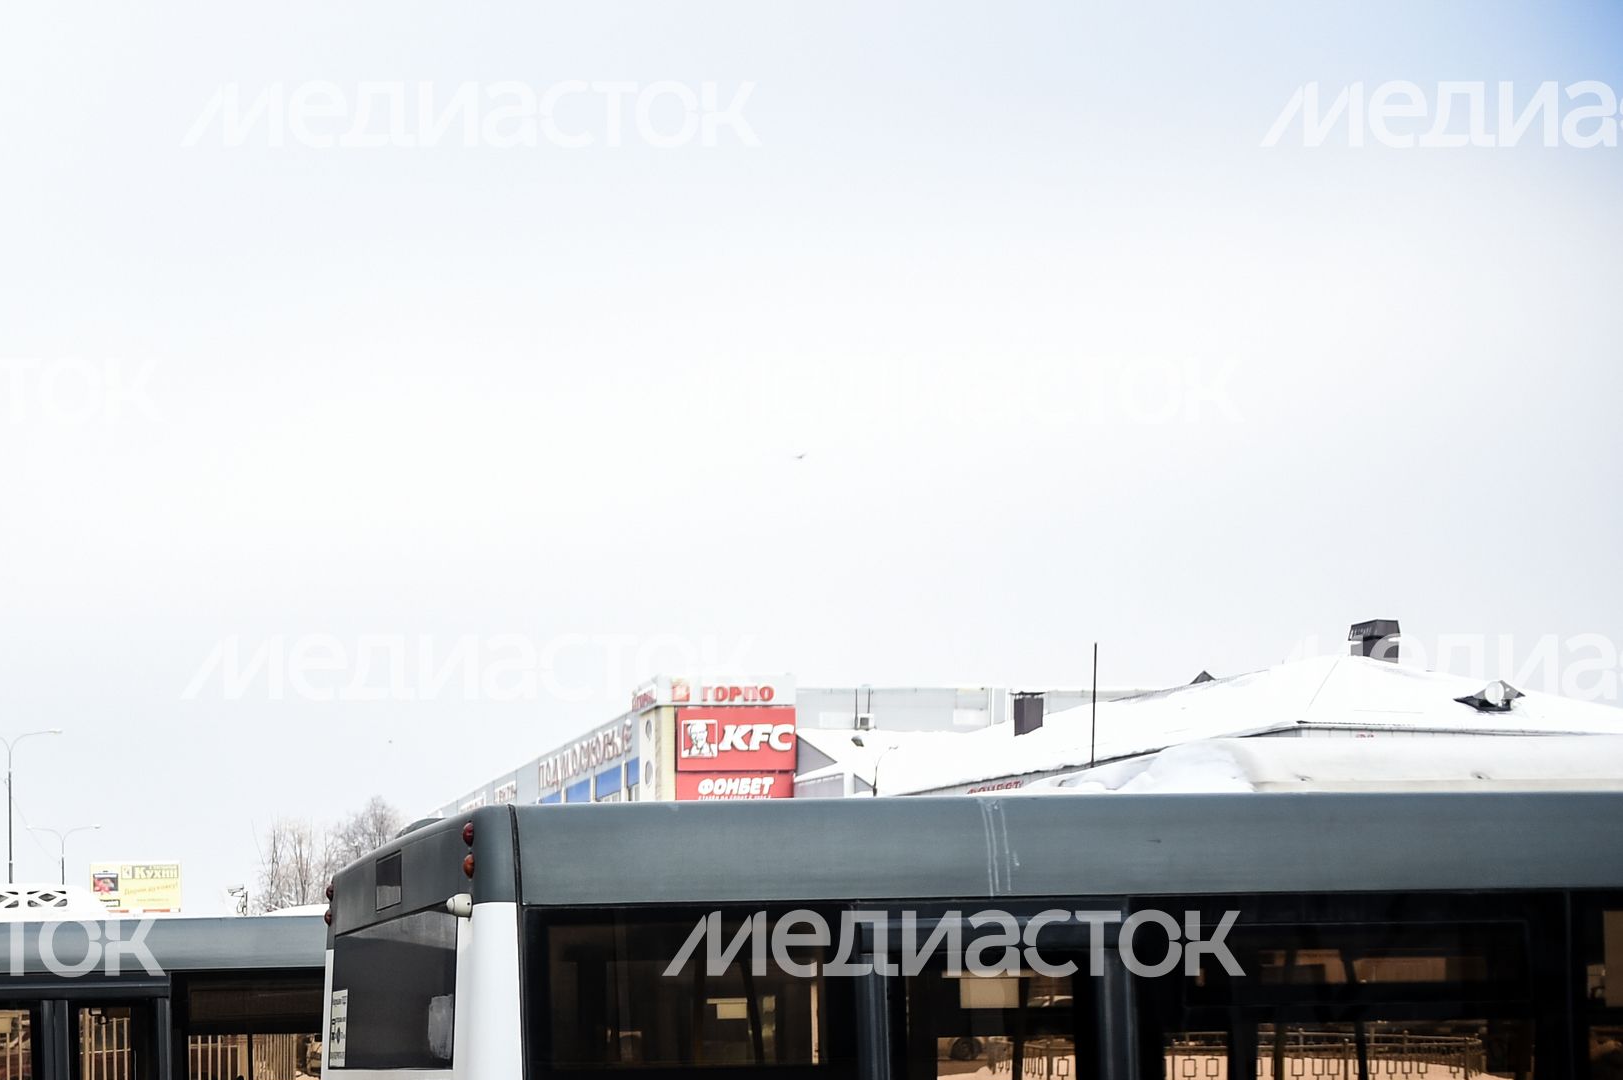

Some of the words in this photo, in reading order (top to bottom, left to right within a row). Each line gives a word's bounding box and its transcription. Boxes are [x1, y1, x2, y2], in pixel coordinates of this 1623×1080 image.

[701, 685, 775, 702] ГОРПО
[719, 724, 795, 751] KFC
[698, 777, 774, 795] ФОНБЕТ
